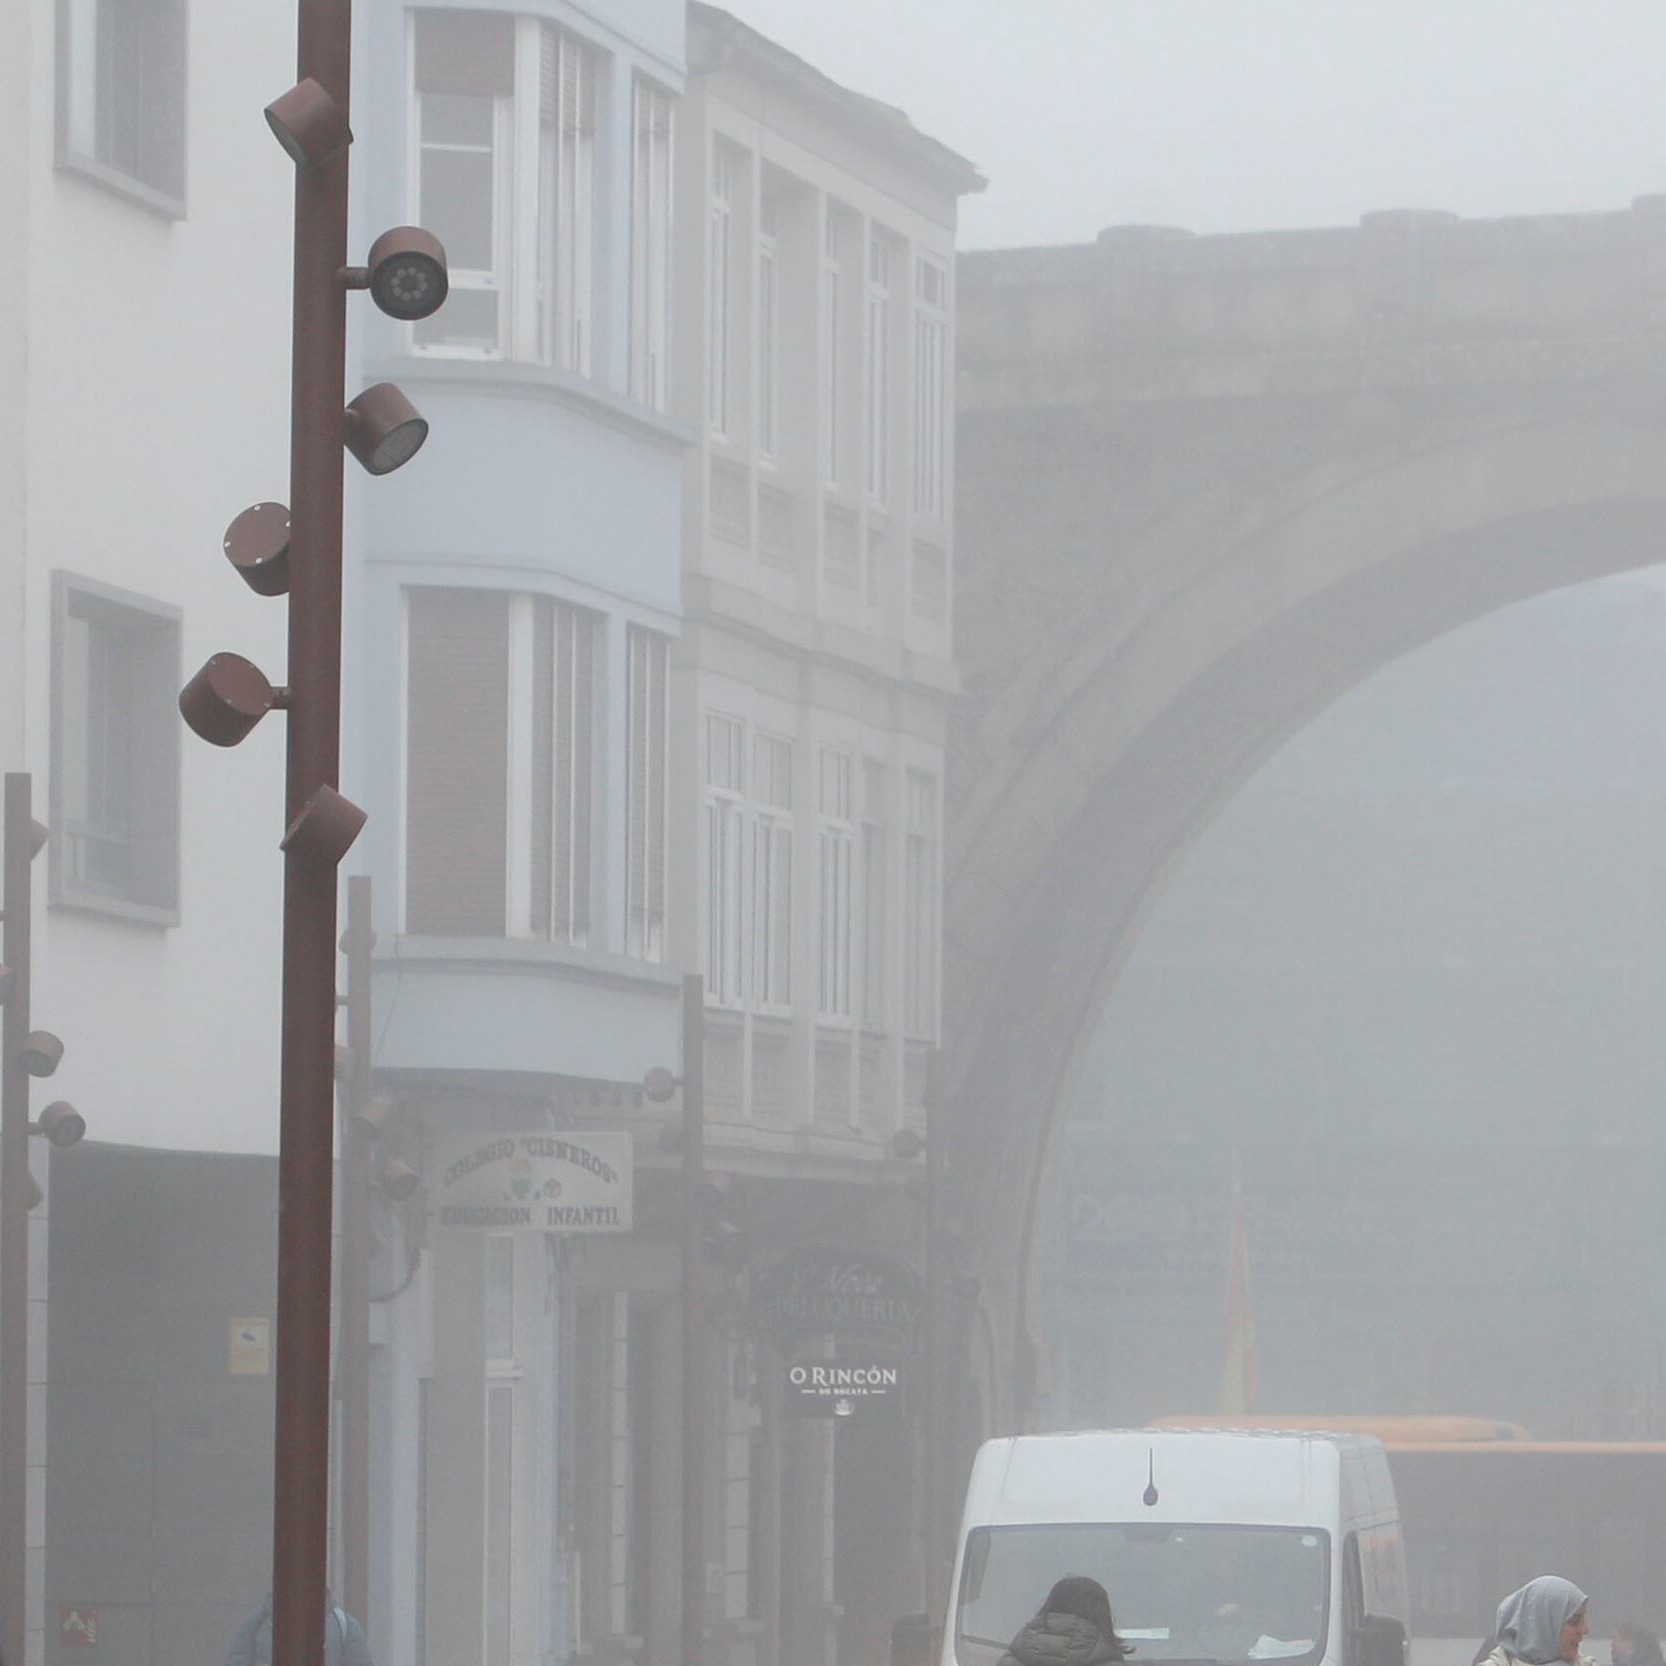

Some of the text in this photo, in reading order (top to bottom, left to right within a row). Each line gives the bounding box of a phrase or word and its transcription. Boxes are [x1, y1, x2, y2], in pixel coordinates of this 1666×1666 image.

[444, 1138, 515, 1189] COLEGIO
[547, 1206, 620, 1225] INFANTIL
[790, 1366, 807, 1384] O
